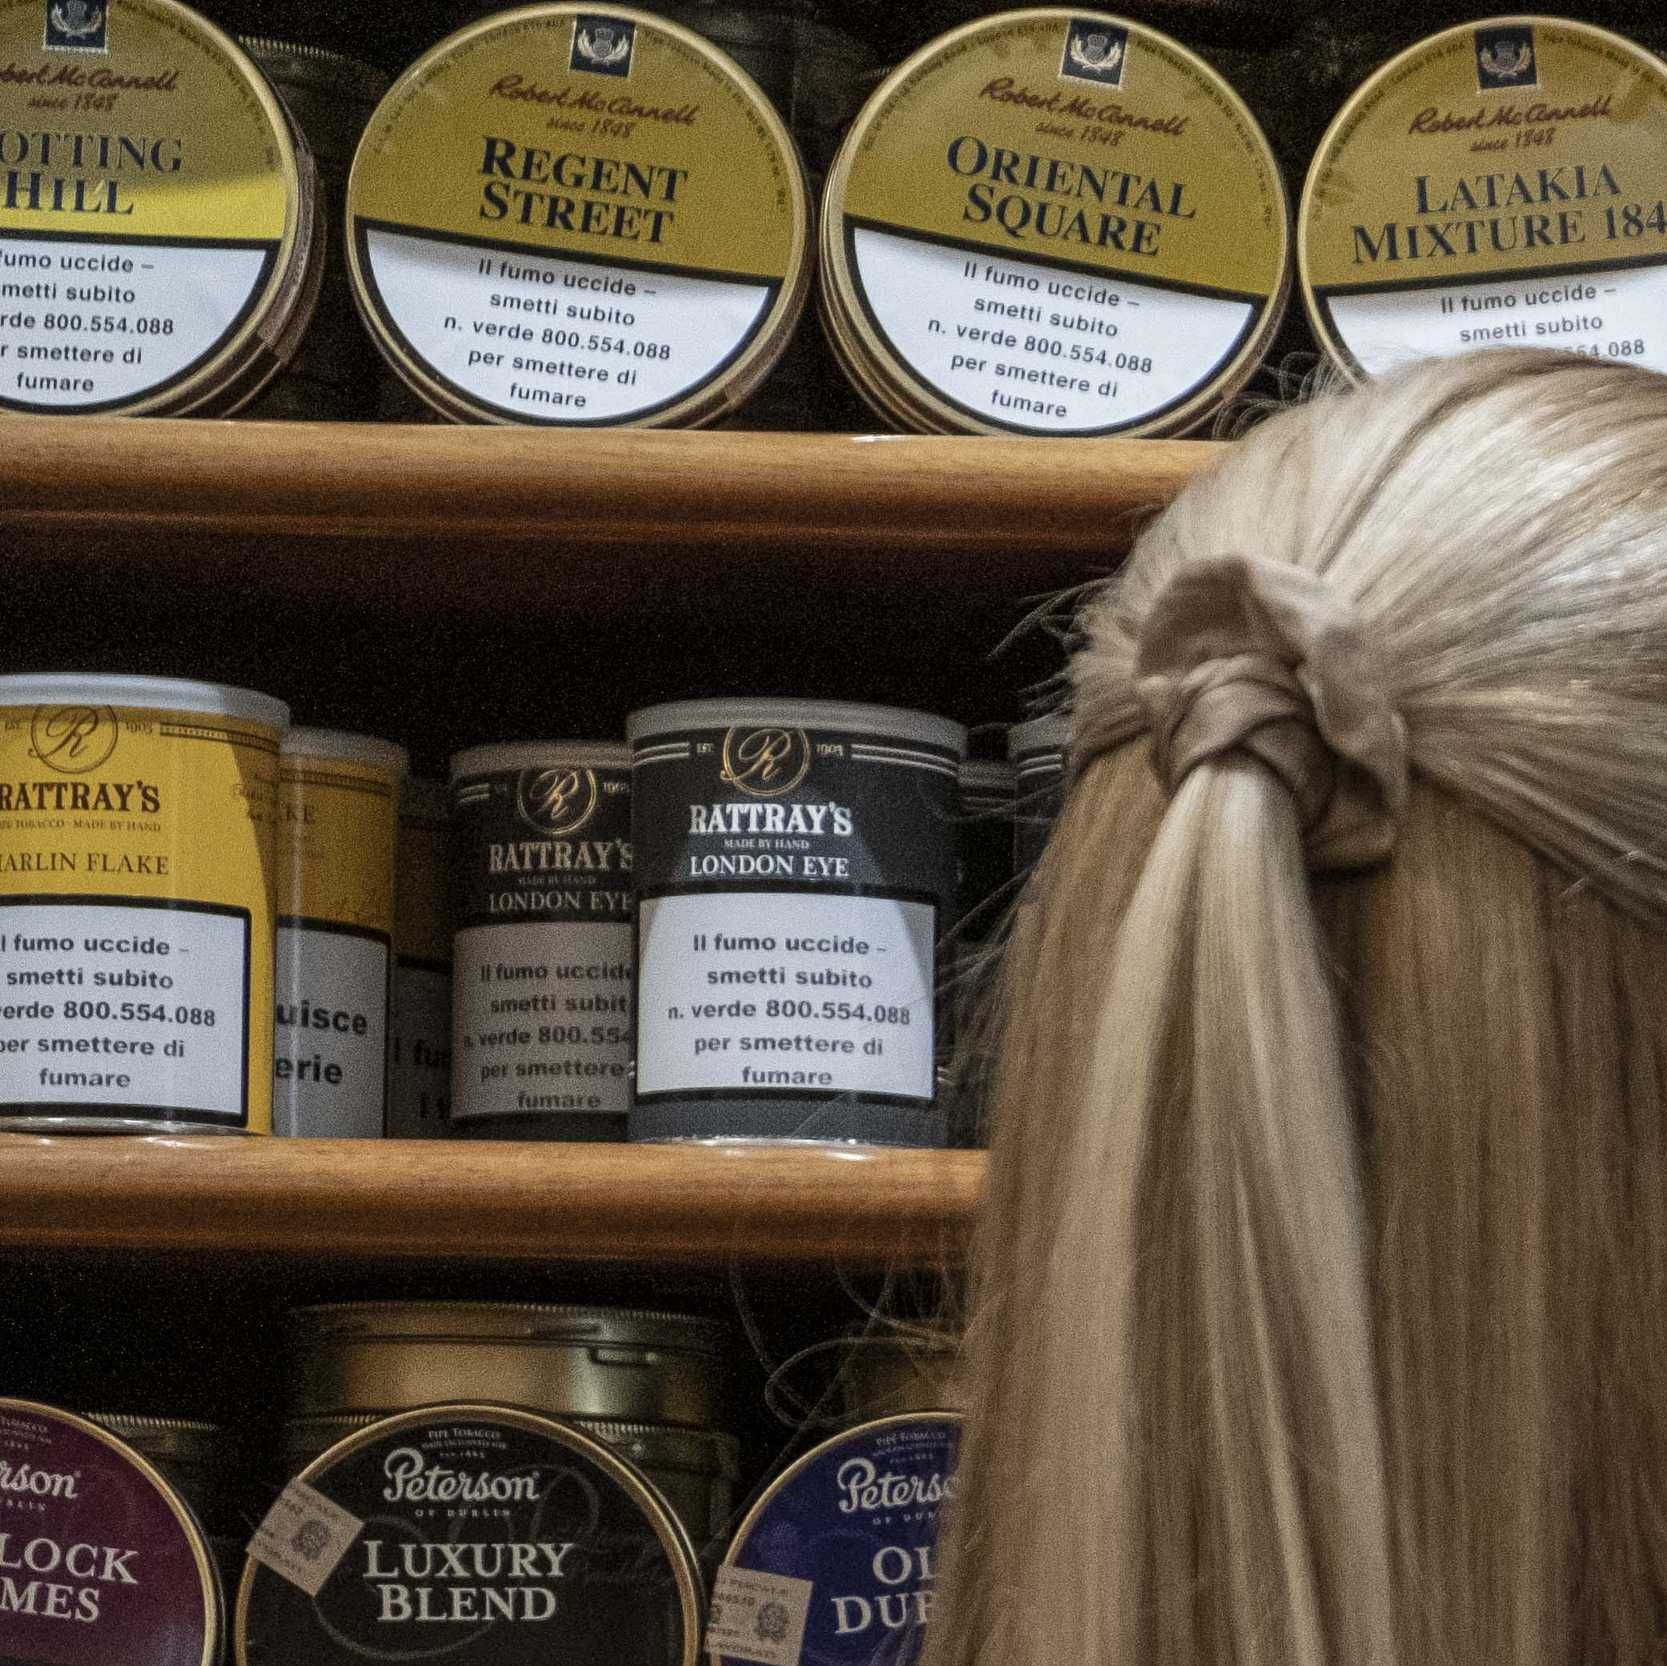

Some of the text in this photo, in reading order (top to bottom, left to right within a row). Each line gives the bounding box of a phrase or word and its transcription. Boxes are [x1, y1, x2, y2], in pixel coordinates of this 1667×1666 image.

[478, 137, 688, 202] REGENT
[946, 135, 1196, 219] ORIENTAL
[1414, 161, 1622, 215] LATAKIA
[6, 170, 134, 214] HILL
[478, 181, 675, 245] STREET
[962, 183, 1160, 258] SQUARE
[1351, 207, 1586, 265] MIXTURE
[964, 262, 1120, 307] Il fumo uccide
[974, 295, 1118, 338] smetti subito
[928, 319, 1153, 374] n. verde 800.554.088
[950, 353, 1118, 398] per smettere di
[991, 389, 1068, 419] fumare
[688, 802, 853, 837] RATTRAY'S
[87, 854, 169, 876] FLAKE
[724, 838, 811, 851] MADE BY HAND
[690, 854, 850, 878] LONDON EYE
[692, 933, 870, 957] Il fumo uccide
[706, 966, 873, 989] smetti subito
[668, 1000, 911, 1026] n. verde 800.554.088
[693, 1035, 884, 1058] per smettere di
[741, 1065, 833, 1088] fumare
[383, 1447, 540, 1503] Peterson
[363, 1539, 576, 1579] LUXURY
[377, 1583, 558, 1623] BLEND
